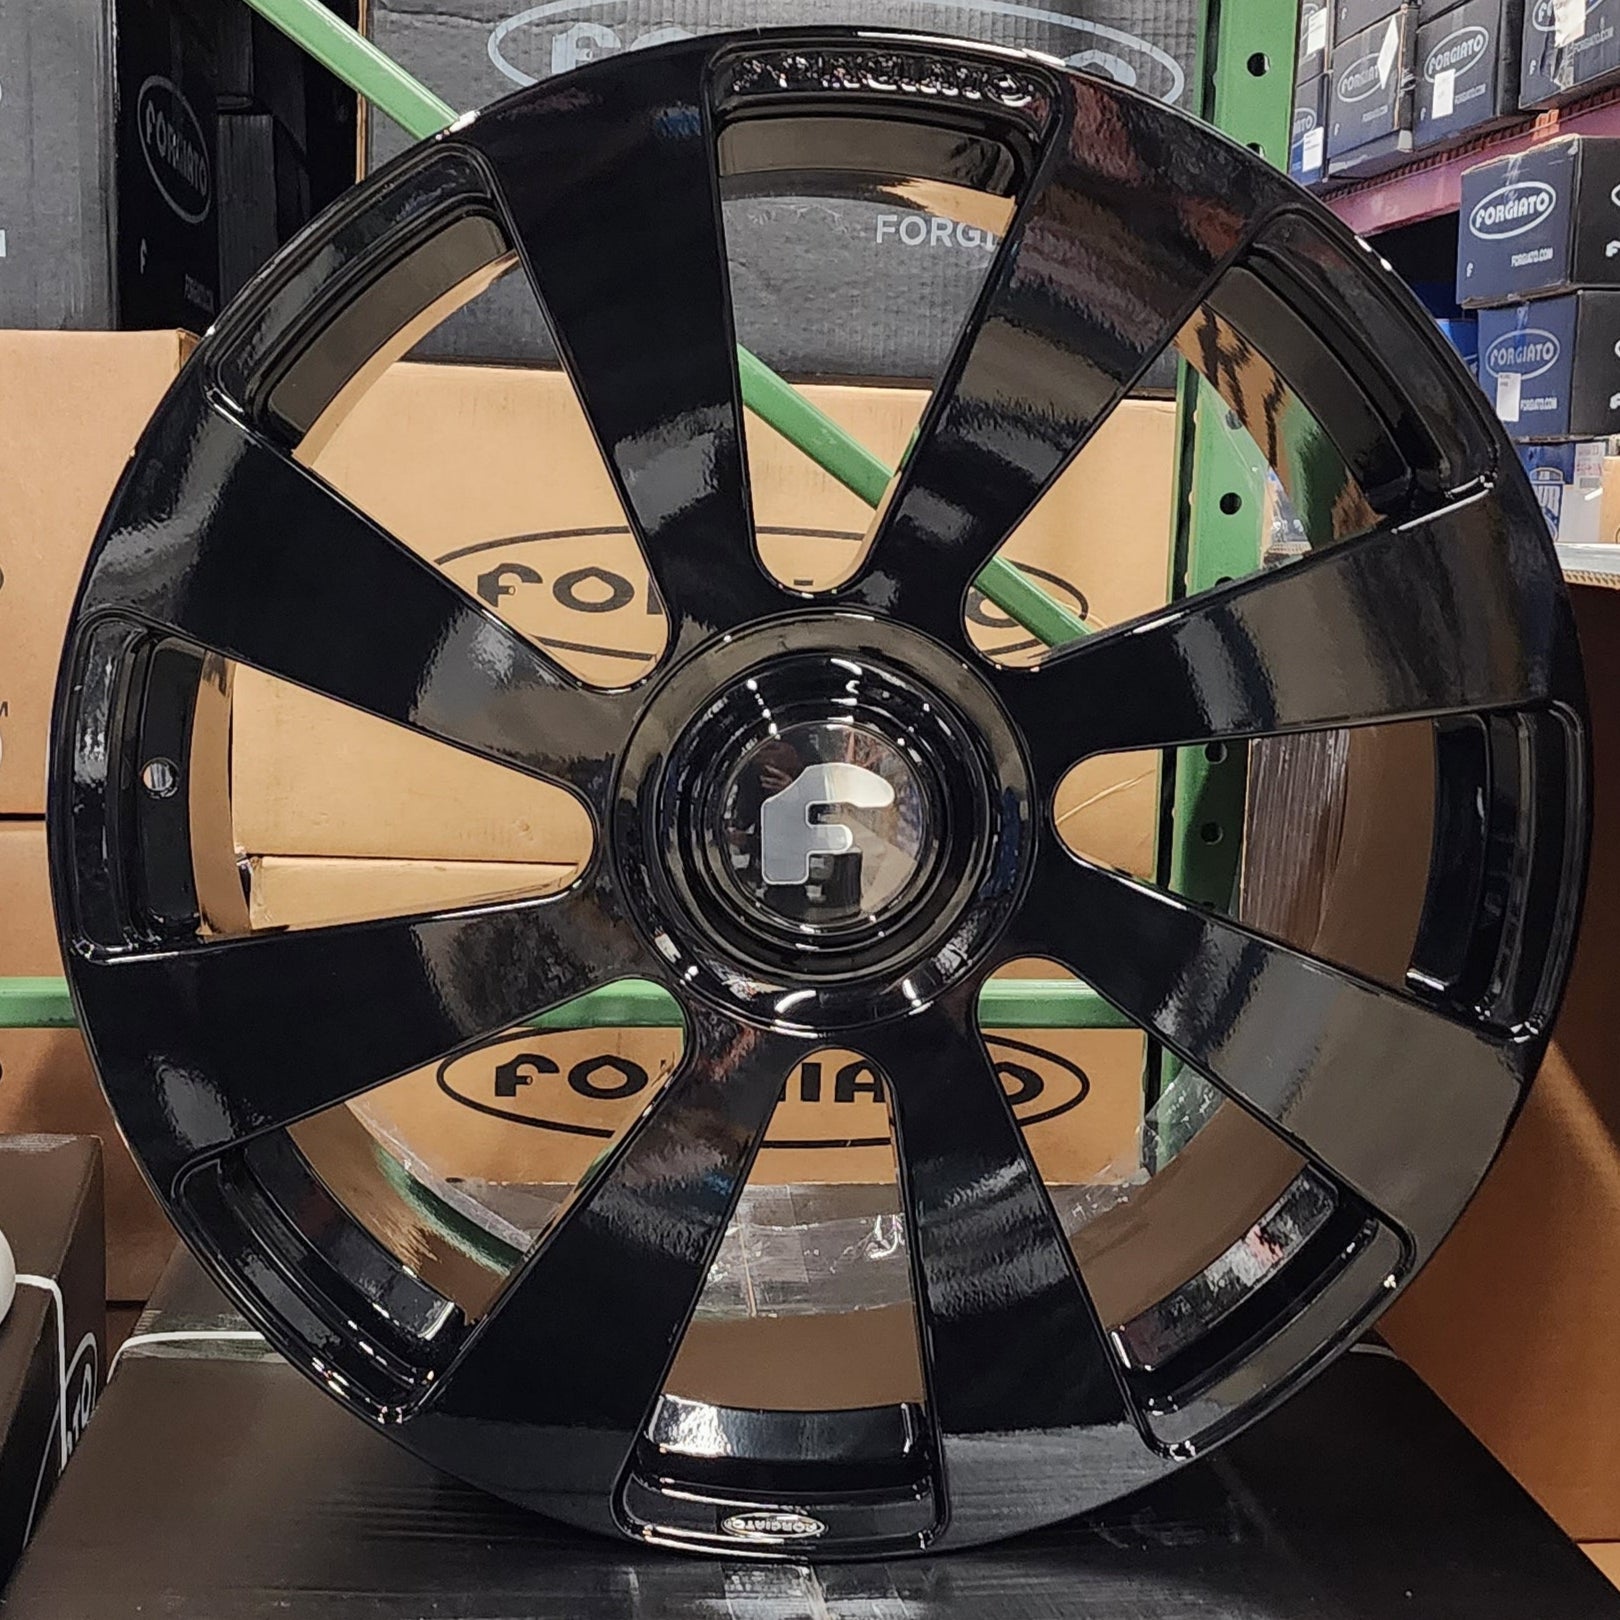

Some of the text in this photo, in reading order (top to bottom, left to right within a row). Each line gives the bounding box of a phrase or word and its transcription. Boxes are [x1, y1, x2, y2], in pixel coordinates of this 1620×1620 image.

[1427, 33, 1484, 75] FORGIATO
[1475, 191, 1550, 228] FORGIATO
[1489, 341, 1555, 367] FORGIATO
